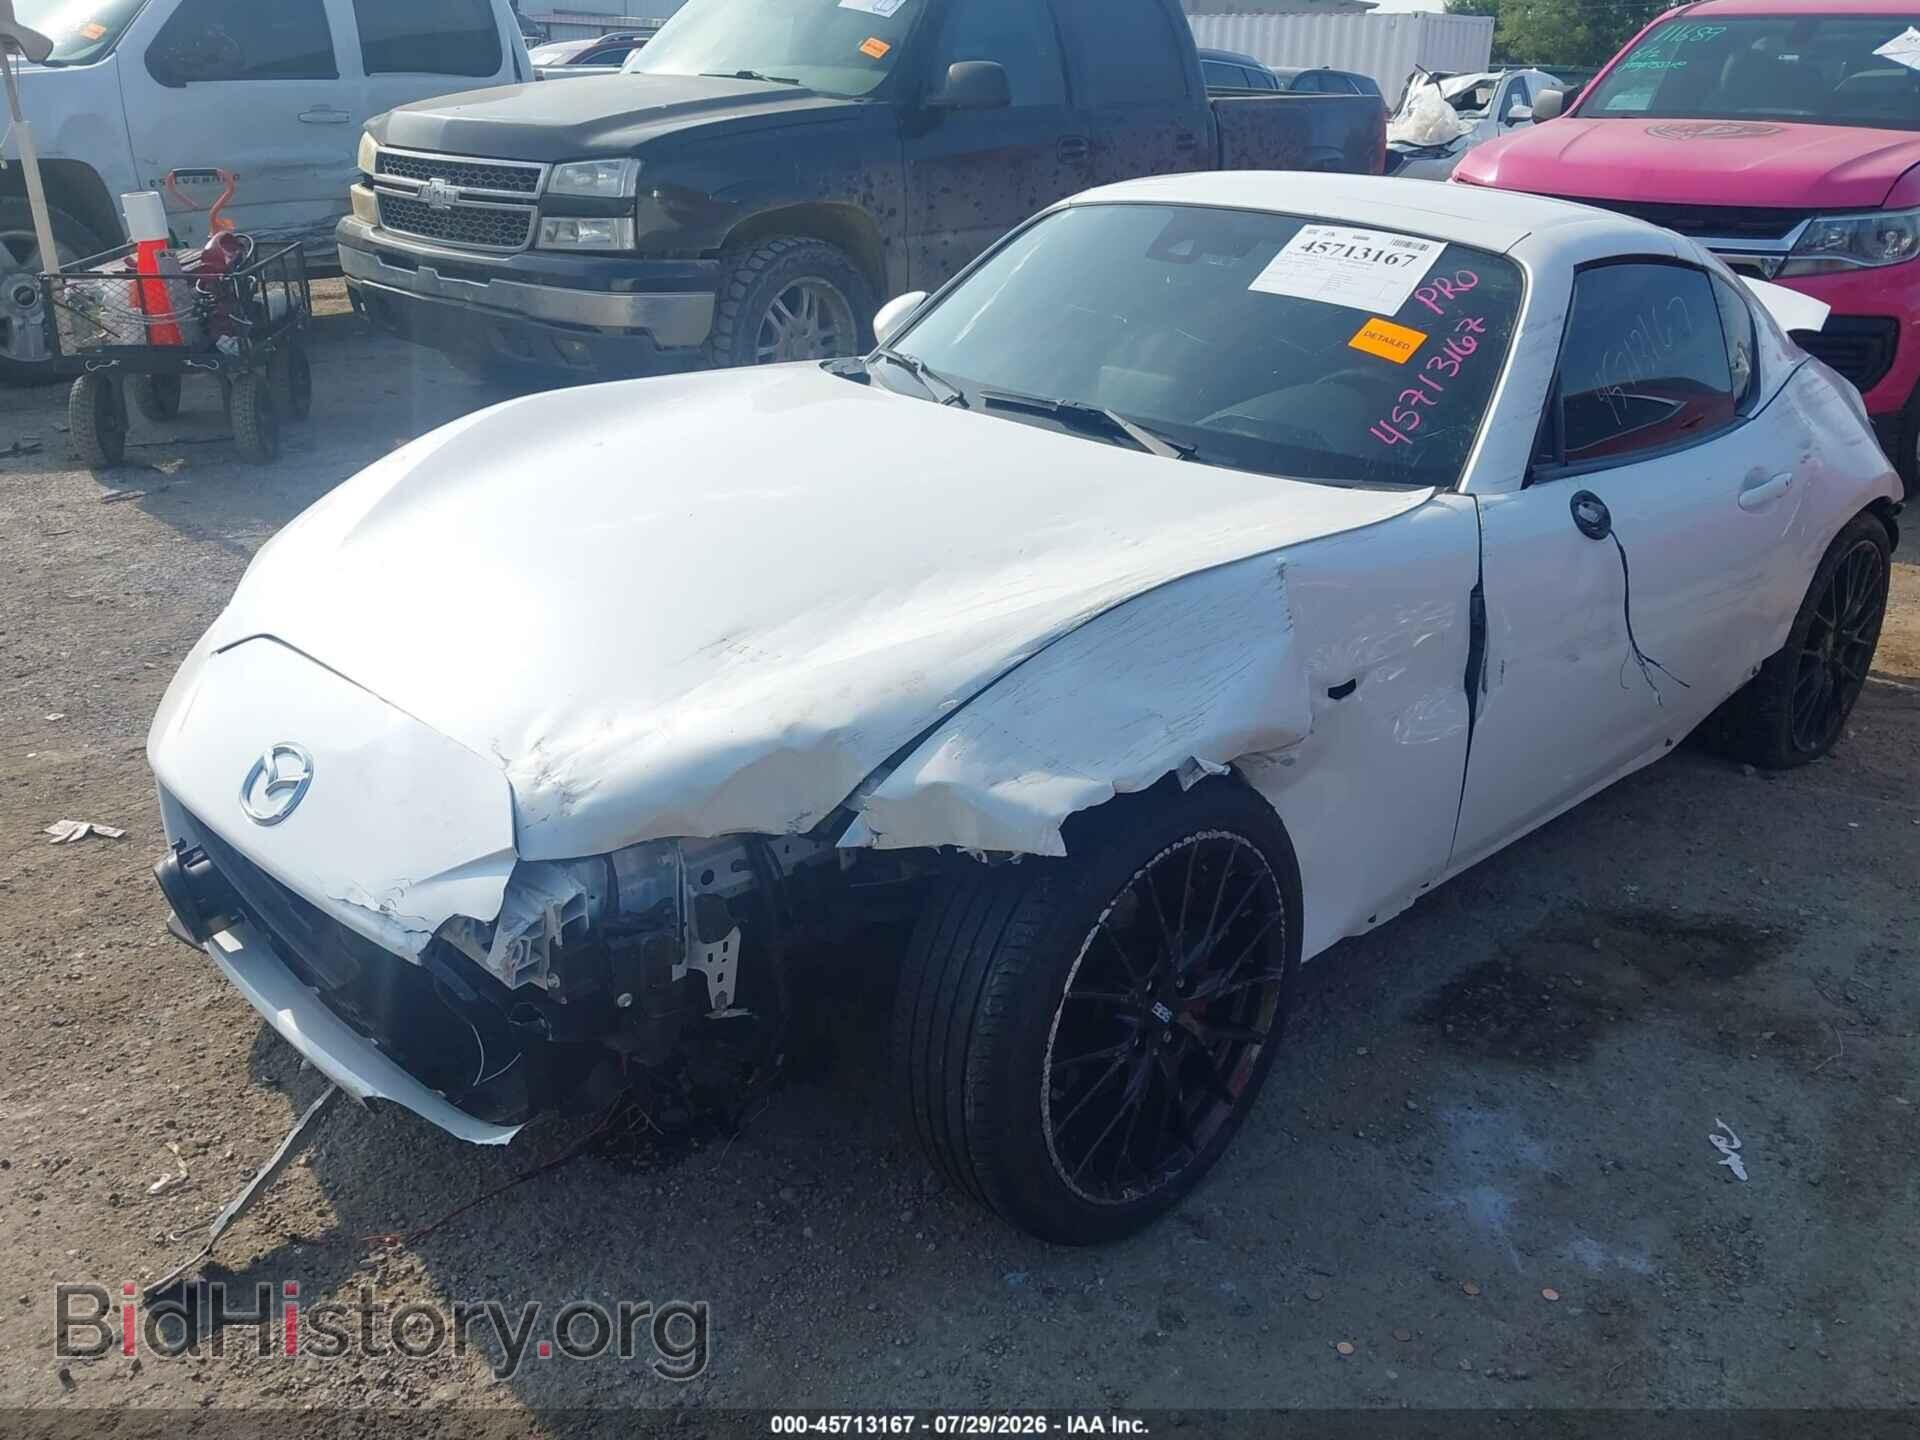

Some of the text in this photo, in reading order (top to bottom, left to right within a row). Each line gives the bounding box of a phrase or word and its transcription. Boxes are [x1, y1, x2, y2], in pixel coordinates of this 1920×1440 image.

[1301, 240, 1418, 268] 45713167
[1414, 270, 1479, 315] PRO
[1363, 330, 1410, 350] DETAILED
[1370, 317, 1486, 444] 45713167
